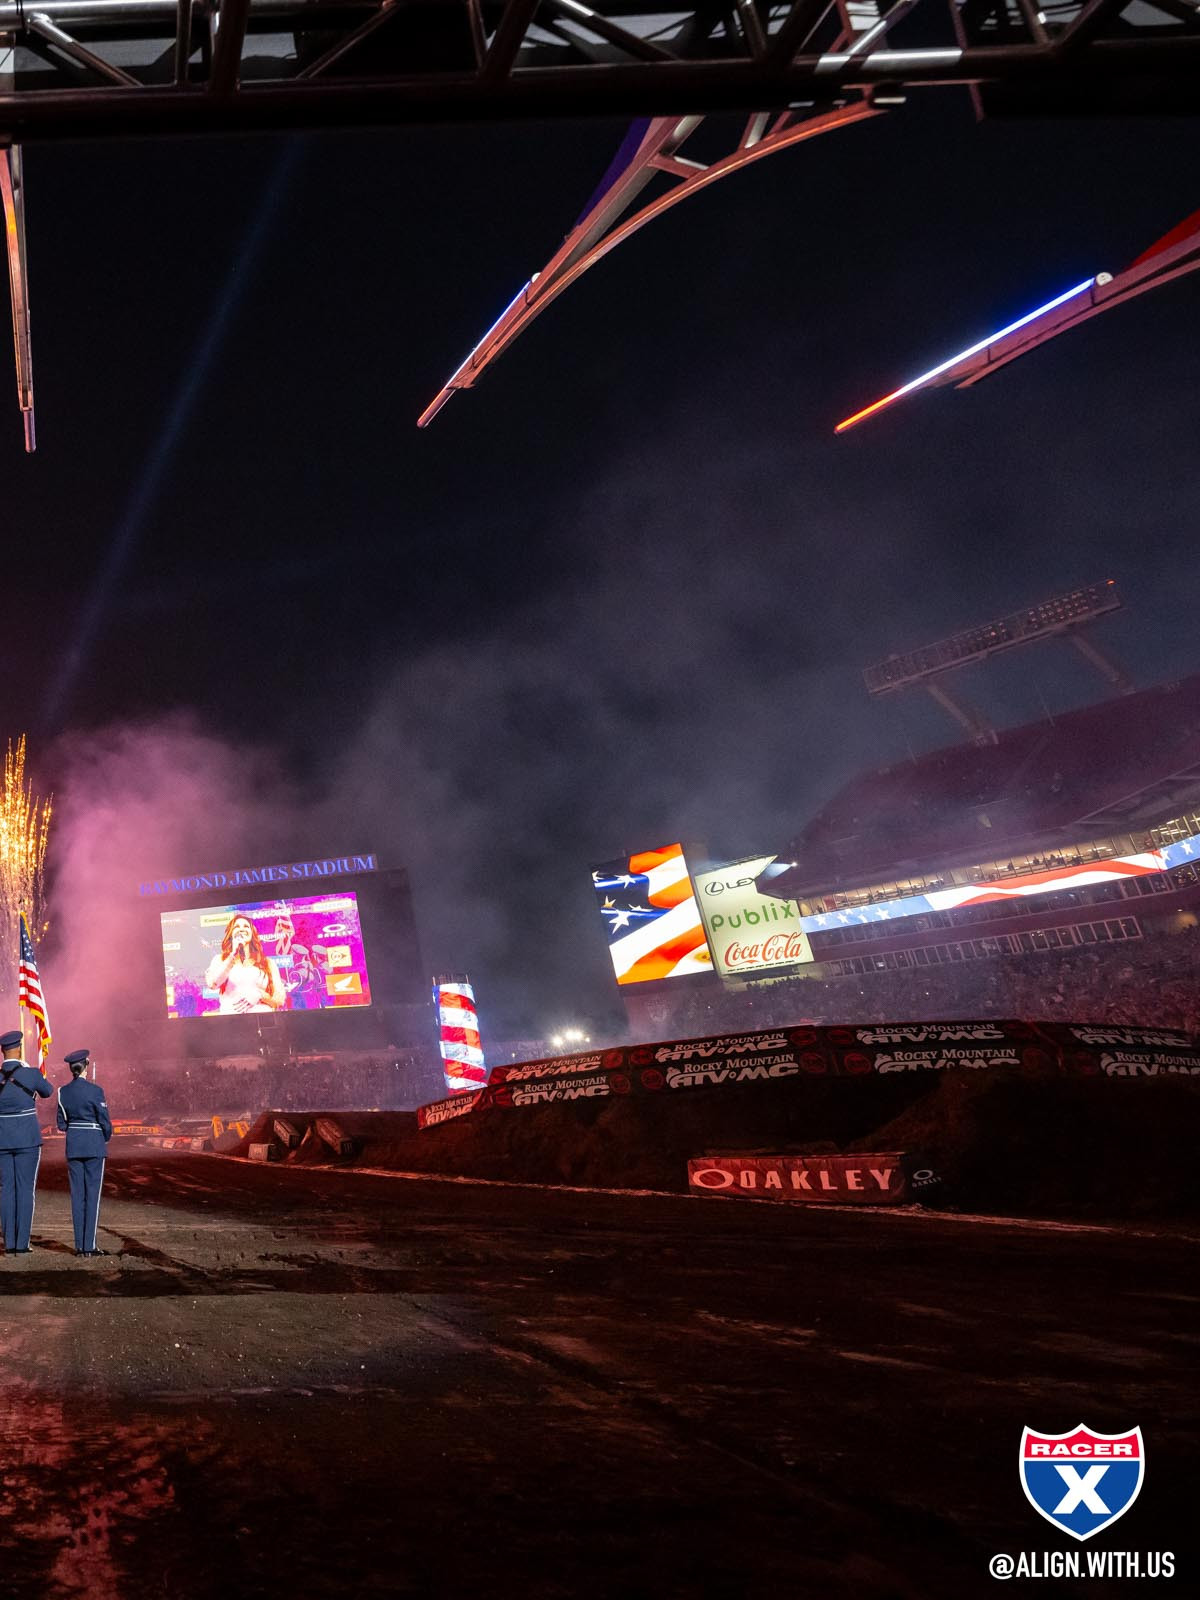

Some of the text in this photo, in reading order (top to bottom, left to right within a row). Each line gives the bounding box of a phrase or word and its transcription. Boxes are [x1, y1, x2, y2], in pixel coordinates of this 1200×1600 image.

[139, 855, 375, 897] RAYMOND JAMES STADIUM
[875, 1023, 996, 1034] ROCKY MOUNTAIN
[674, 1042, 715, 1052] ROCKY
[715, 1033, 785, 1048] MOUNTAIN
[893, 1049, 1016, 1061] ROCKY MOUNTAIN
[1114, 1051, 1153, 1063] ROCKY
[521, 1063, 550, 1072] ROCKY
[684, 1062, 725, 1073] ROCKY
[726, 1053, 795, 1069] MOUNTAIN
[524, 1082, 554, 1093] ROCKY
[555, 1075, 607, 1090] MOUNTAIN
[739, 1168, 894, 1190] OAKLEY
[912, 1176, 943, 1188] OAKLEY
